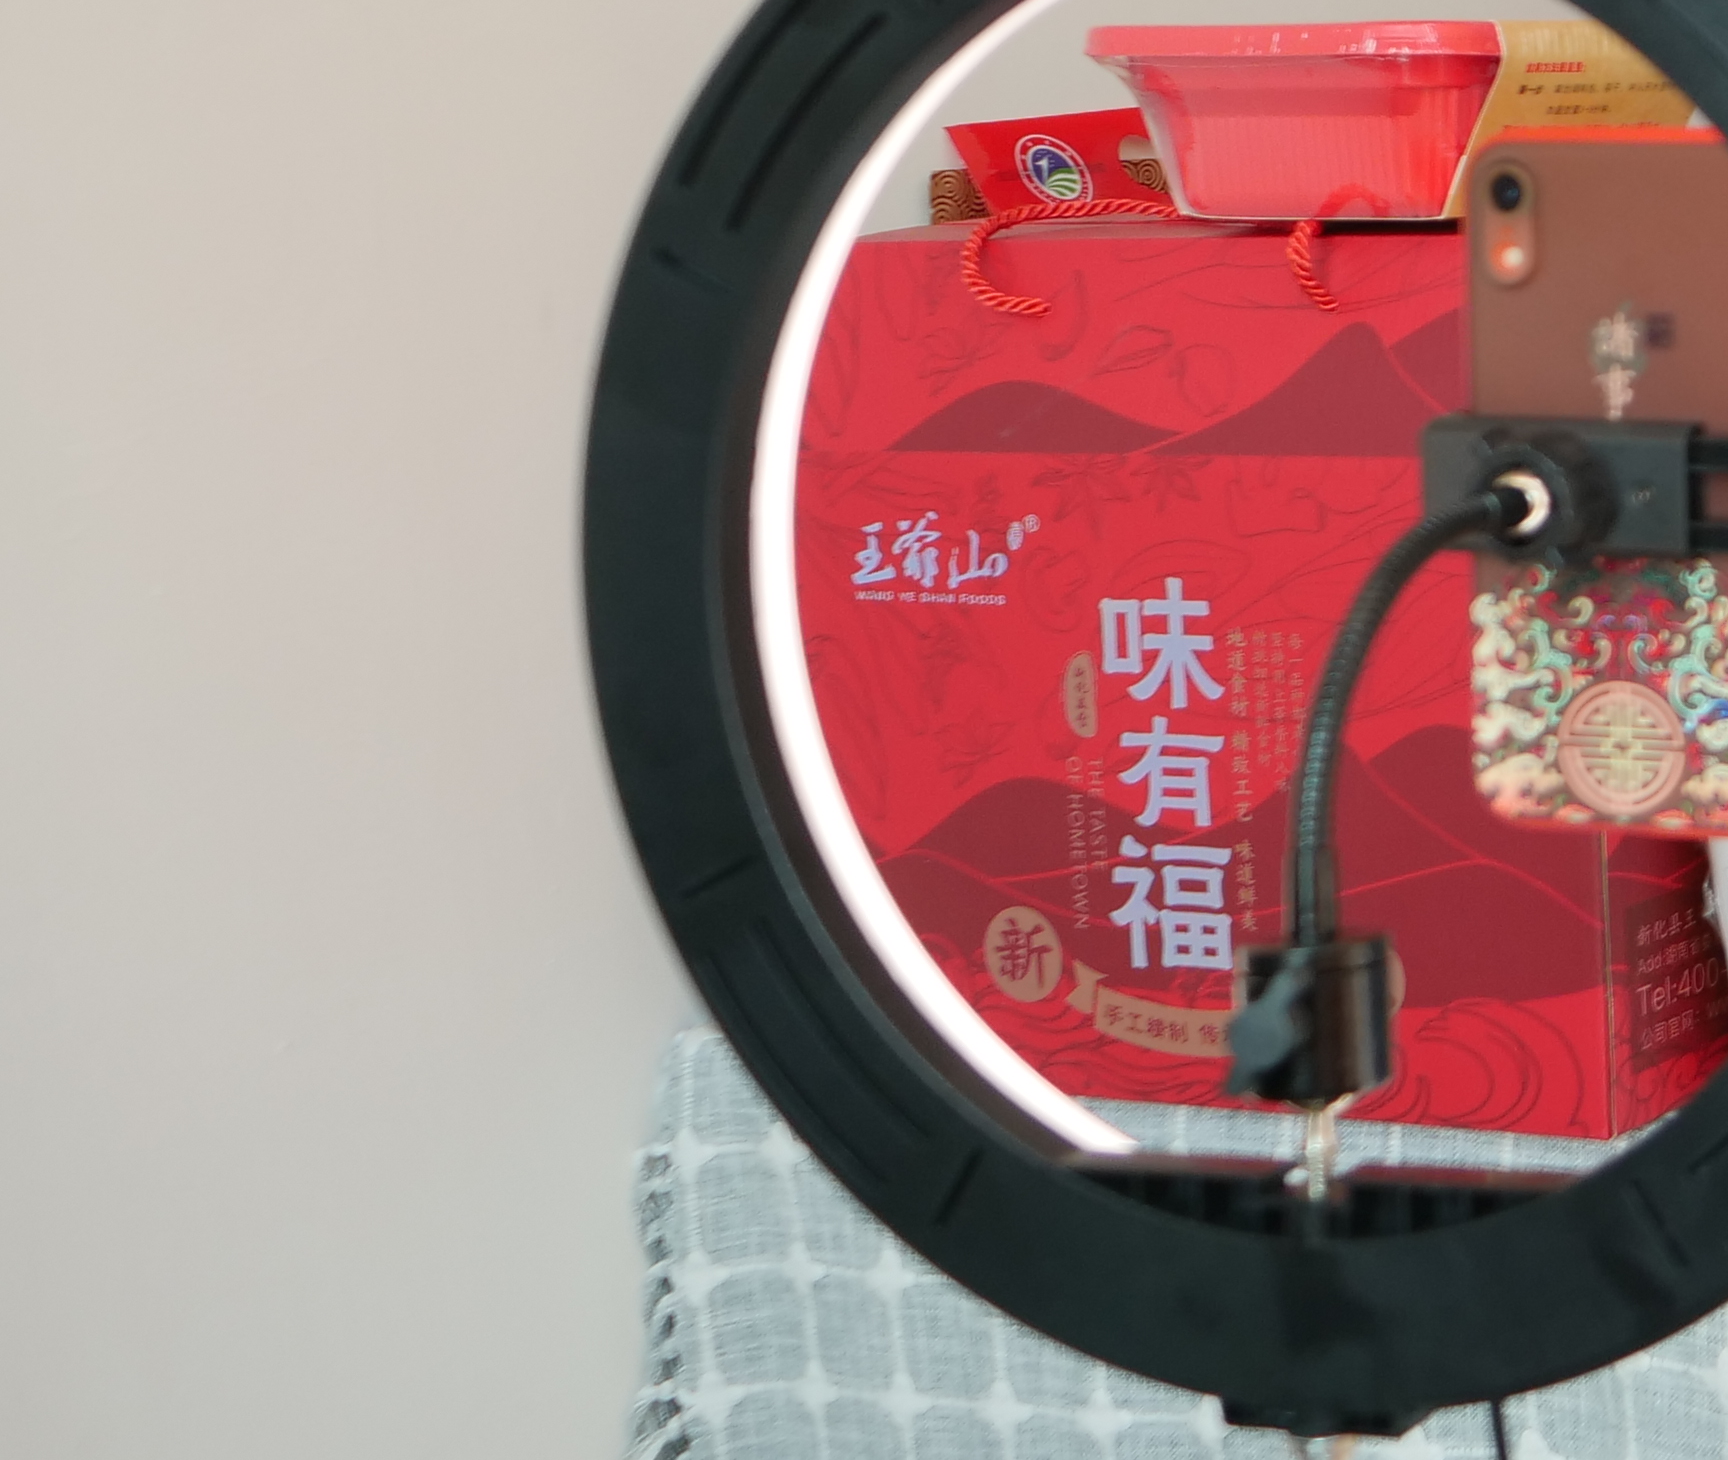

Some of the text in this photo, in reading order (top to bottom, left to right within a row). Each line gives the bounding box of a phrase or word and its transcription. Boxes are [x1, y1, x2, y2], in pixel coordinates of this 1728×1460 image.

[1065, 756, 1084, 785] OF
[1098, 576, 1234, 971] 味有福
[1065, 793, 1091, 930] HOMETOWN
[1089, 809, 1108, 873] TASTE
[995, 918, 1053, 990] 新
